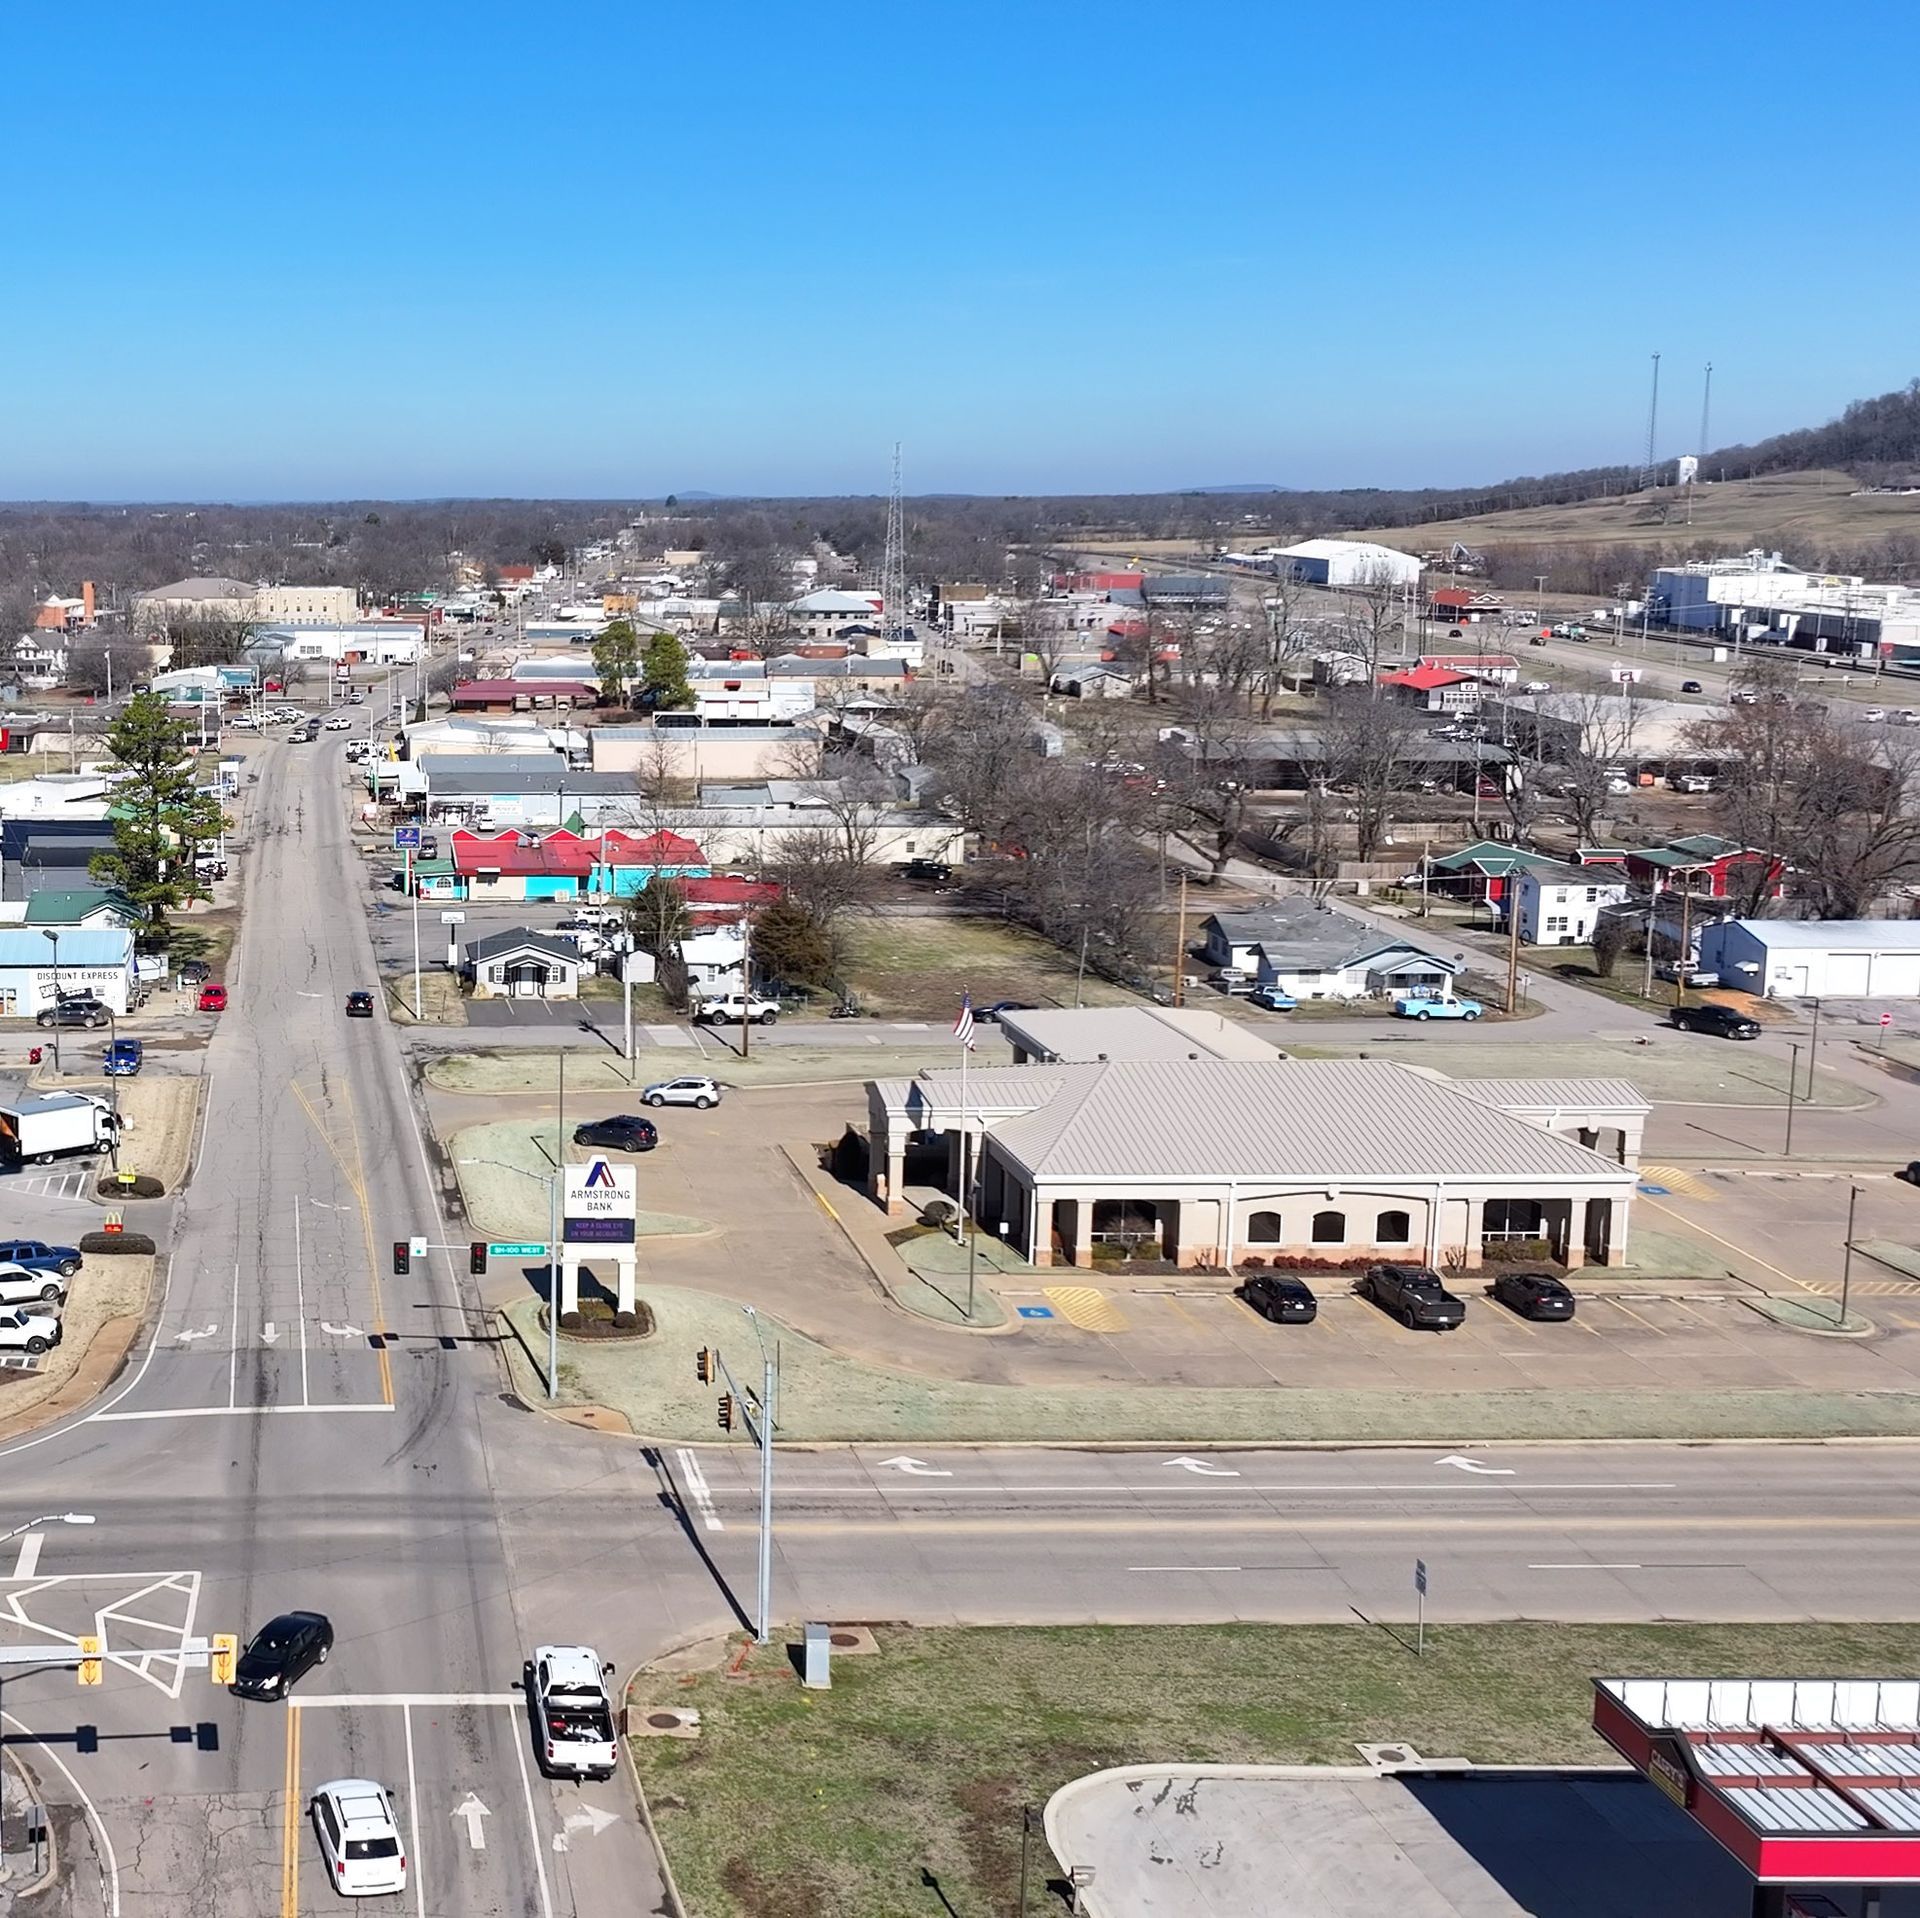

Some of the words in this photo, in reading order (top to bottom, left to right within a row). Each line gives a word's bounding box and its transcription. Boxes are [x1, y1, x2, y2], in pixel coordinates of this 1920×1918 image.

[37, 972, 77, 980] DISCOUNT
[81, 972, 118, 980] EXPRESS
[570, 1190, 631, 1200] ARMSTRONG
[587, 1202, 613, 1212] BANK
[521, 1246, 542, 1254] WEST
